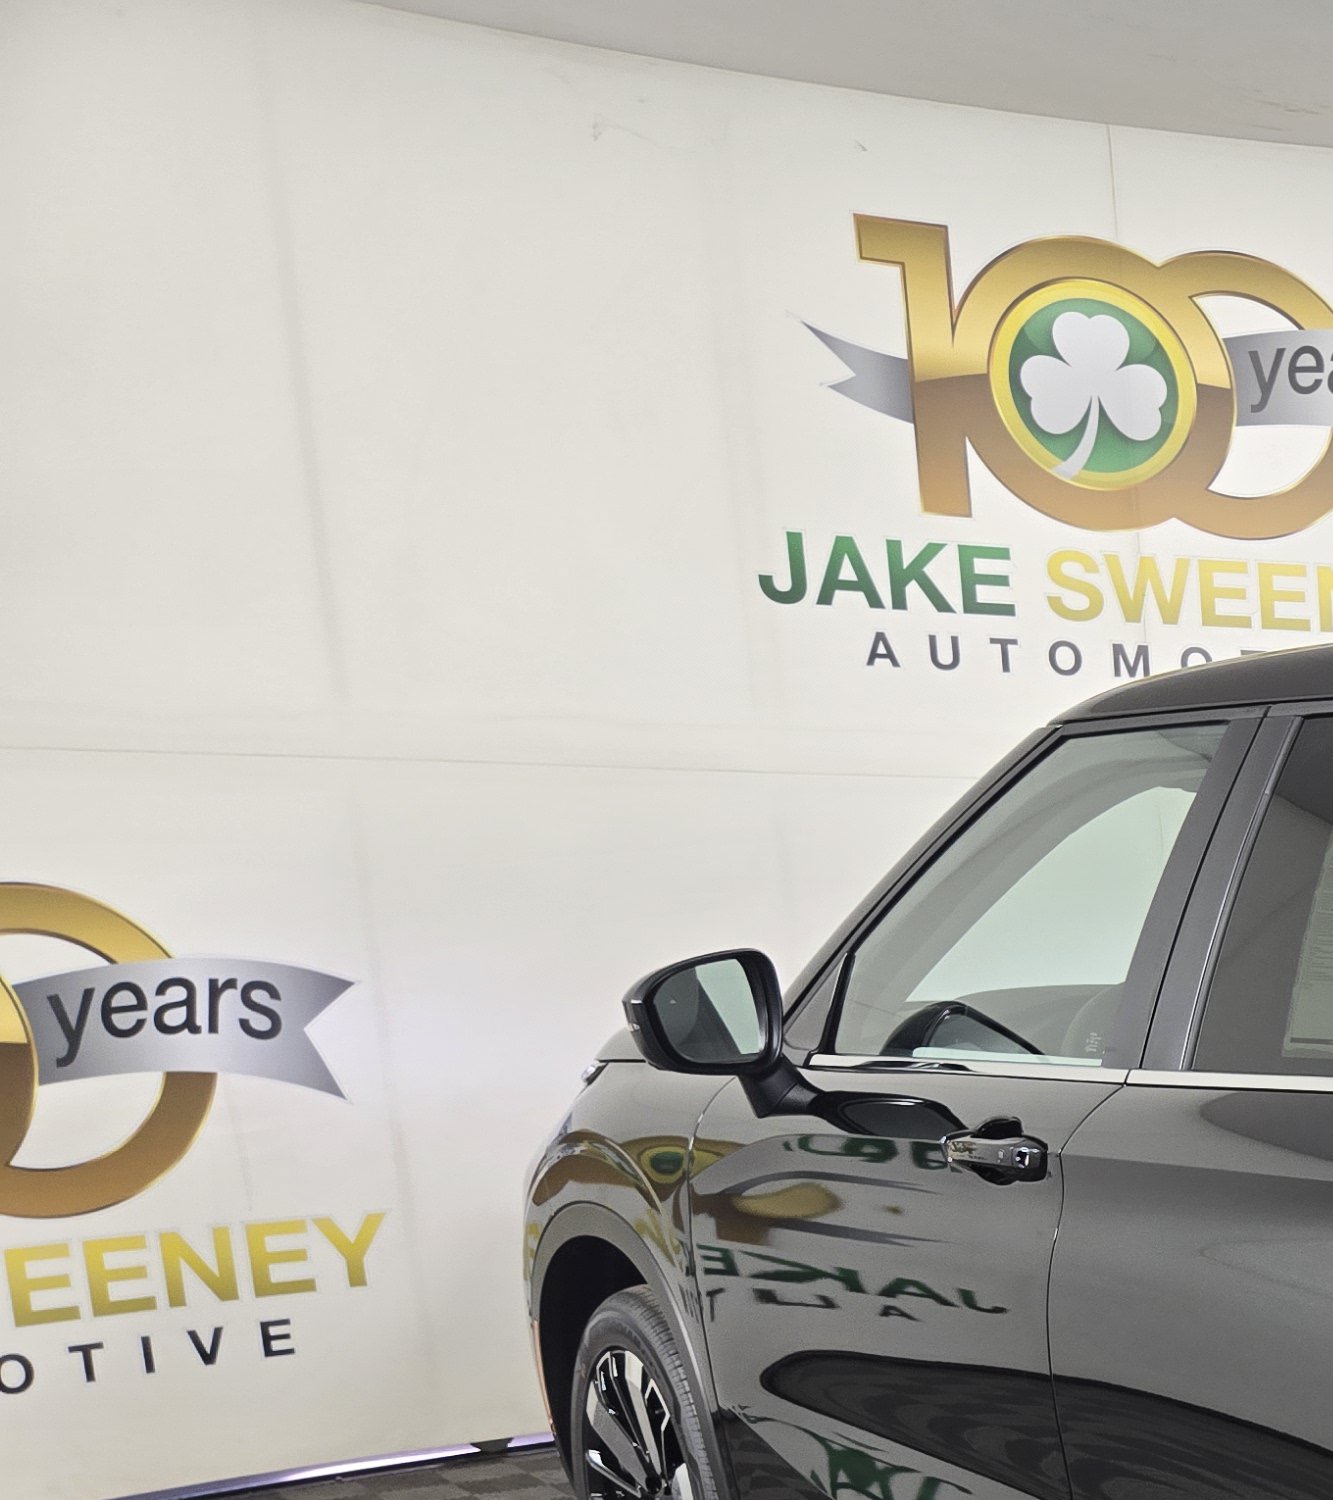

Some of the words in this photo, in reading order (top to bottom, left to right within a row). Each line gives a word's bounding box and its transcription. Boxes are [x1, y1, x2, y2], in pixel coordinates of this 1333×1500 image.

[758, 530, 1015, 616] JAKE
[867, 632, 1270, 678] AUTOMO
[47, 977, 282, 1067] years
